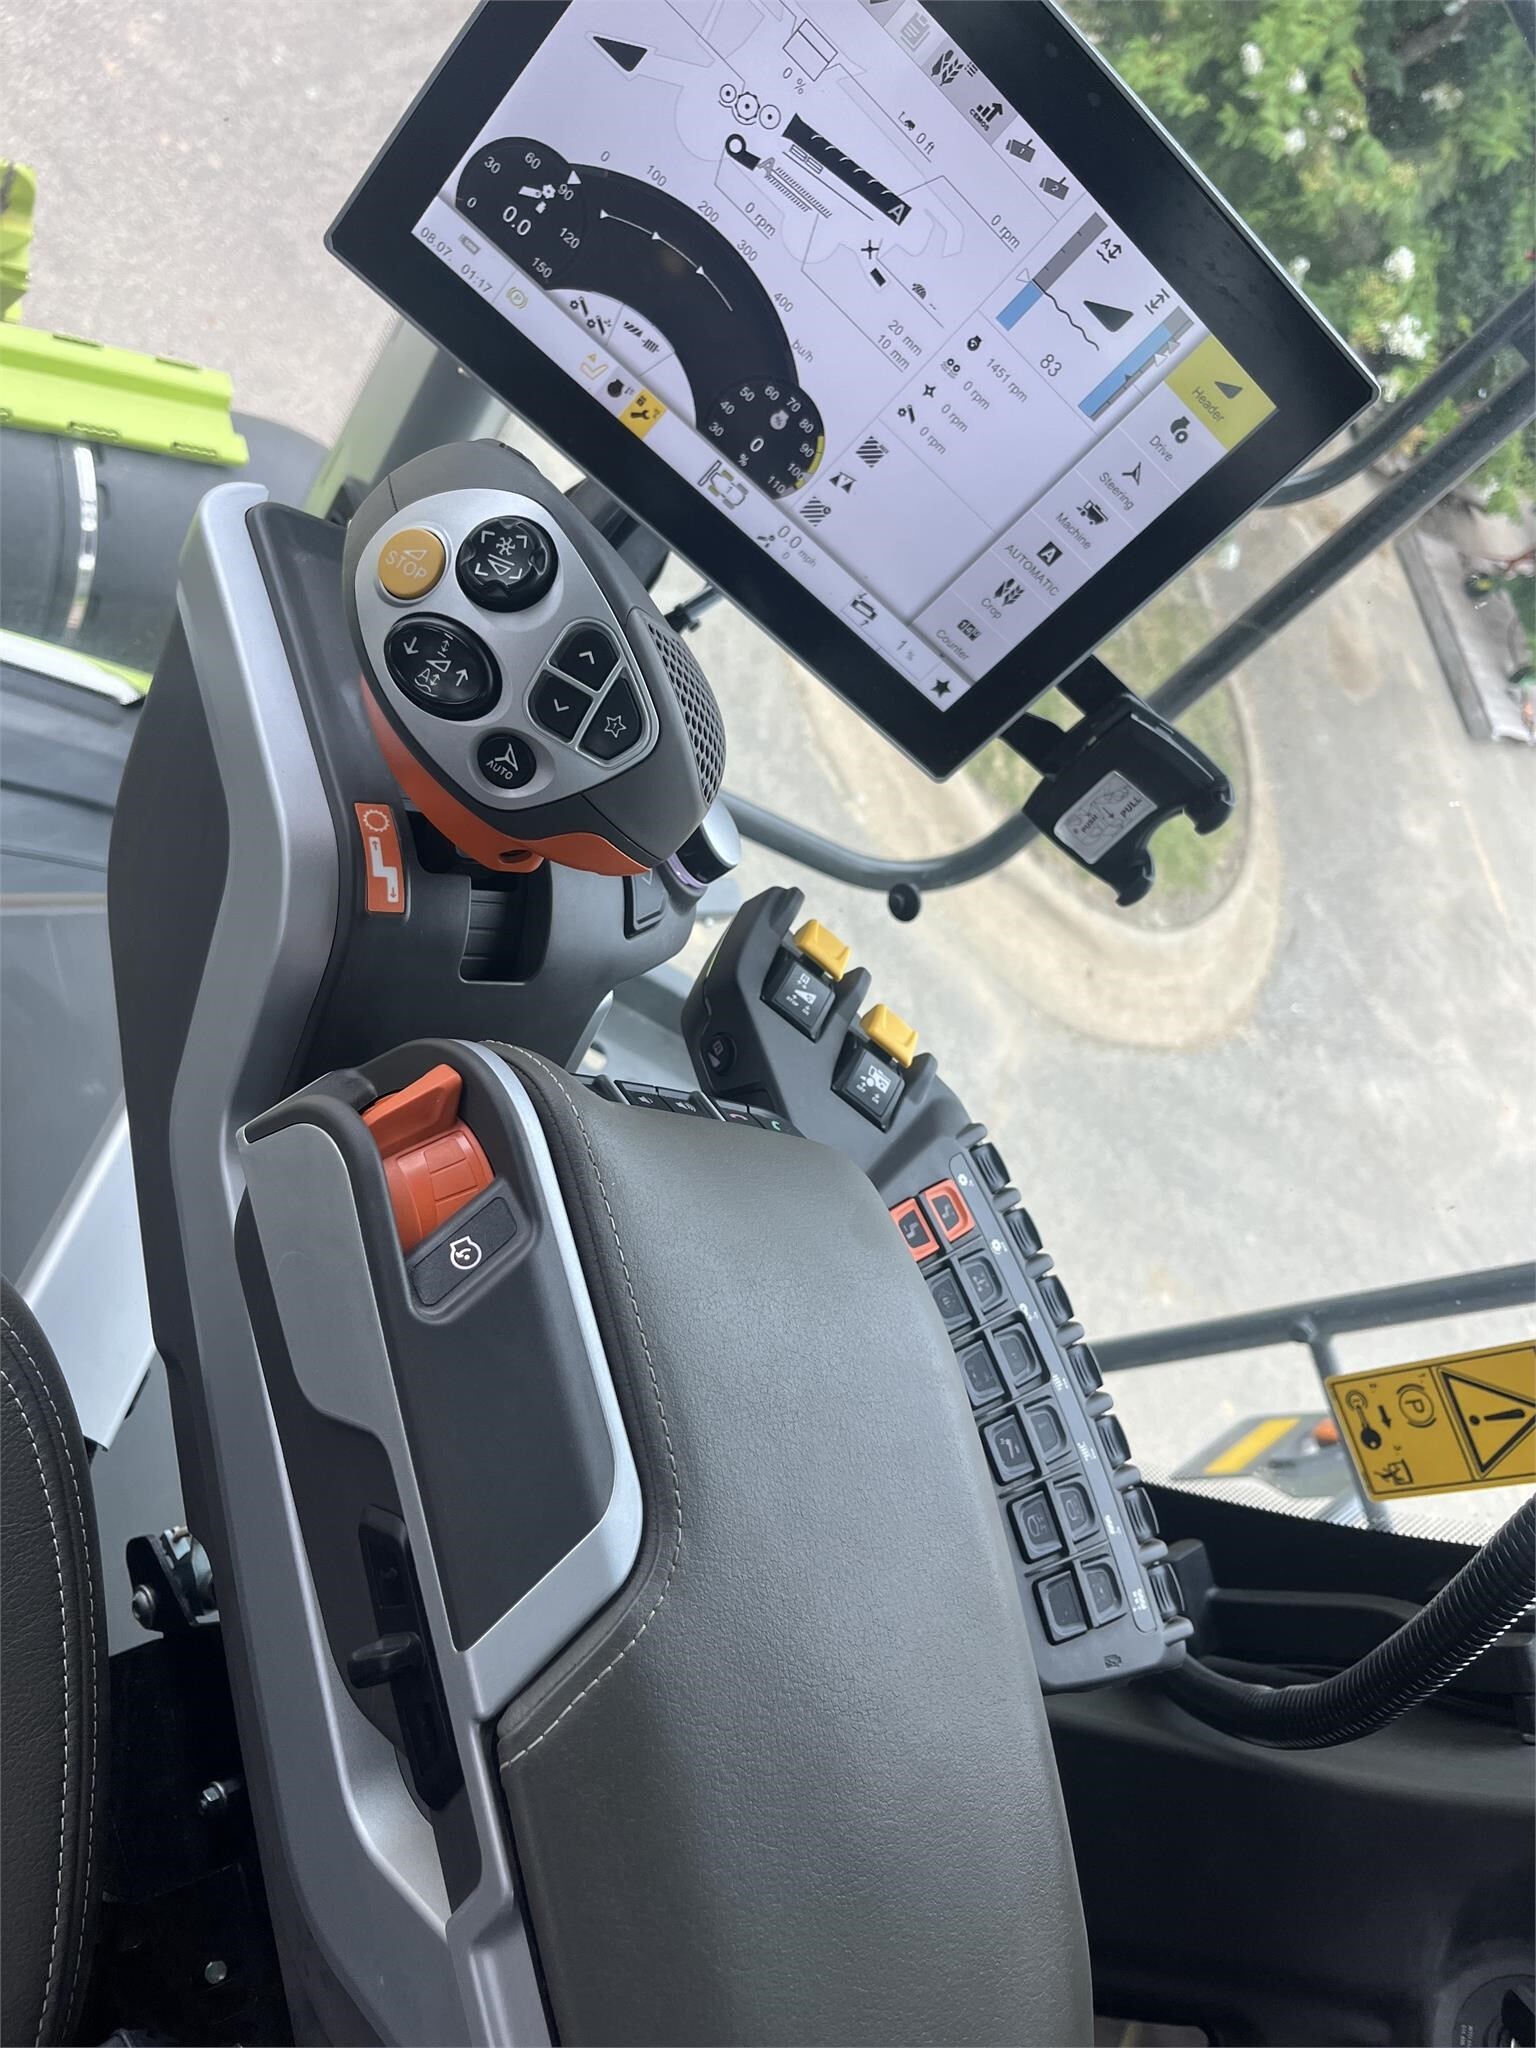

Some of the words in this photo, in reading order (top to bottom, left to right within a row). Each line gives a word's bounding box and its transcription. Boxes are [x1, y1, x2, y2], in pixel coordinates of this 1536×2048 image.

[782, 67, 793, 79] 0
[794, 78, 807, 95] %
[969, 108, 990, 131] CEMOS
[916, 132, 926, 144] 0
[924, 141, 935, 155] ft
[484, 156, 501, 174] 30
[524, 152, 541, 170] 60
[600, 151, 610, 162] 0
[646, 165, 667, 187] 100
[466, 197, 477, 208] 0
[557, 184, 574, 201] 90
[502, 206, 532, 236] 0.0
[697, 201, 719, 223] 200
[745, 202, 755, 214] 0
[754, 215, 776, 237] rpm
[888, 204, 906, 222] A
[559, 227, 581, 249] 120
[991, 214, 1001, 226] 0
[1000, 226, 1021, 249] rpm
[737, 239, 758, 262] 300
[1100, 238, 1111, 249] A
[420, 226, 453, 262] 08.07.
[461, 264, 493, 293] 01:17
[531, 257, 553, 278] 150
[773, 292, 794, 313] 400
[888, 319, 905, 336] 20
[903, 335, 923, 357] mm
[792, 339, 814, 363] bu/h
[877, 334, 892, 350] 10
[890, 349, 910, 371] mm
[1040, 353, 1062, 377] 83
[986, 358, 1011, 383] 1451
[1008, 381, 1029, 403] rpm
[739, 386, 755, 402] 50
[764, 385, 780, 401] 60
[963, 380, 974, 392] 0
[970, 389, 990, 411] rpm
[719, 400, 735, 415] 40
[786, 397, 801, 413] 70
[1191, 386, 1225, 423] Header
[708, 421, 724, 437] 30
[799, 418, 814, 434] 80
[941, 403, 951, 415] 0
[948, 411, 969, 433] rpm
[750, 437, 764, 452] 0
[799, 443, 814, 458] 90
[919, 426, 930, 437] 0
[926, 434, 946, 455] rpm
[1149, 435, 1173, 462] Drive
[738, 453, 749, 467] %
[787, 462, 804, 481] 100
[767, 475, 786, 494] 110
[1099, 472, 1134, 511] Steering
[1056, 512, 1091, 550] Machine
[777, 525, 802, 549] 0.0
[799, 550, 817, 568] mph
[1040, 548, 1057, 564] A
[384, 551, 428, 580] STOP
[1005, 544, 1060, 597] AUTOMATIC
[980, 597, 1002, 619] Crop
[935, 629, 969, 661] Counter
[486, 760, 514, 781] AUTO
[1120, 797, 1141, 818] PULL
[1081, 815, 1098, 833] PUSH
[1405, 1399, 1425, 1413] P
